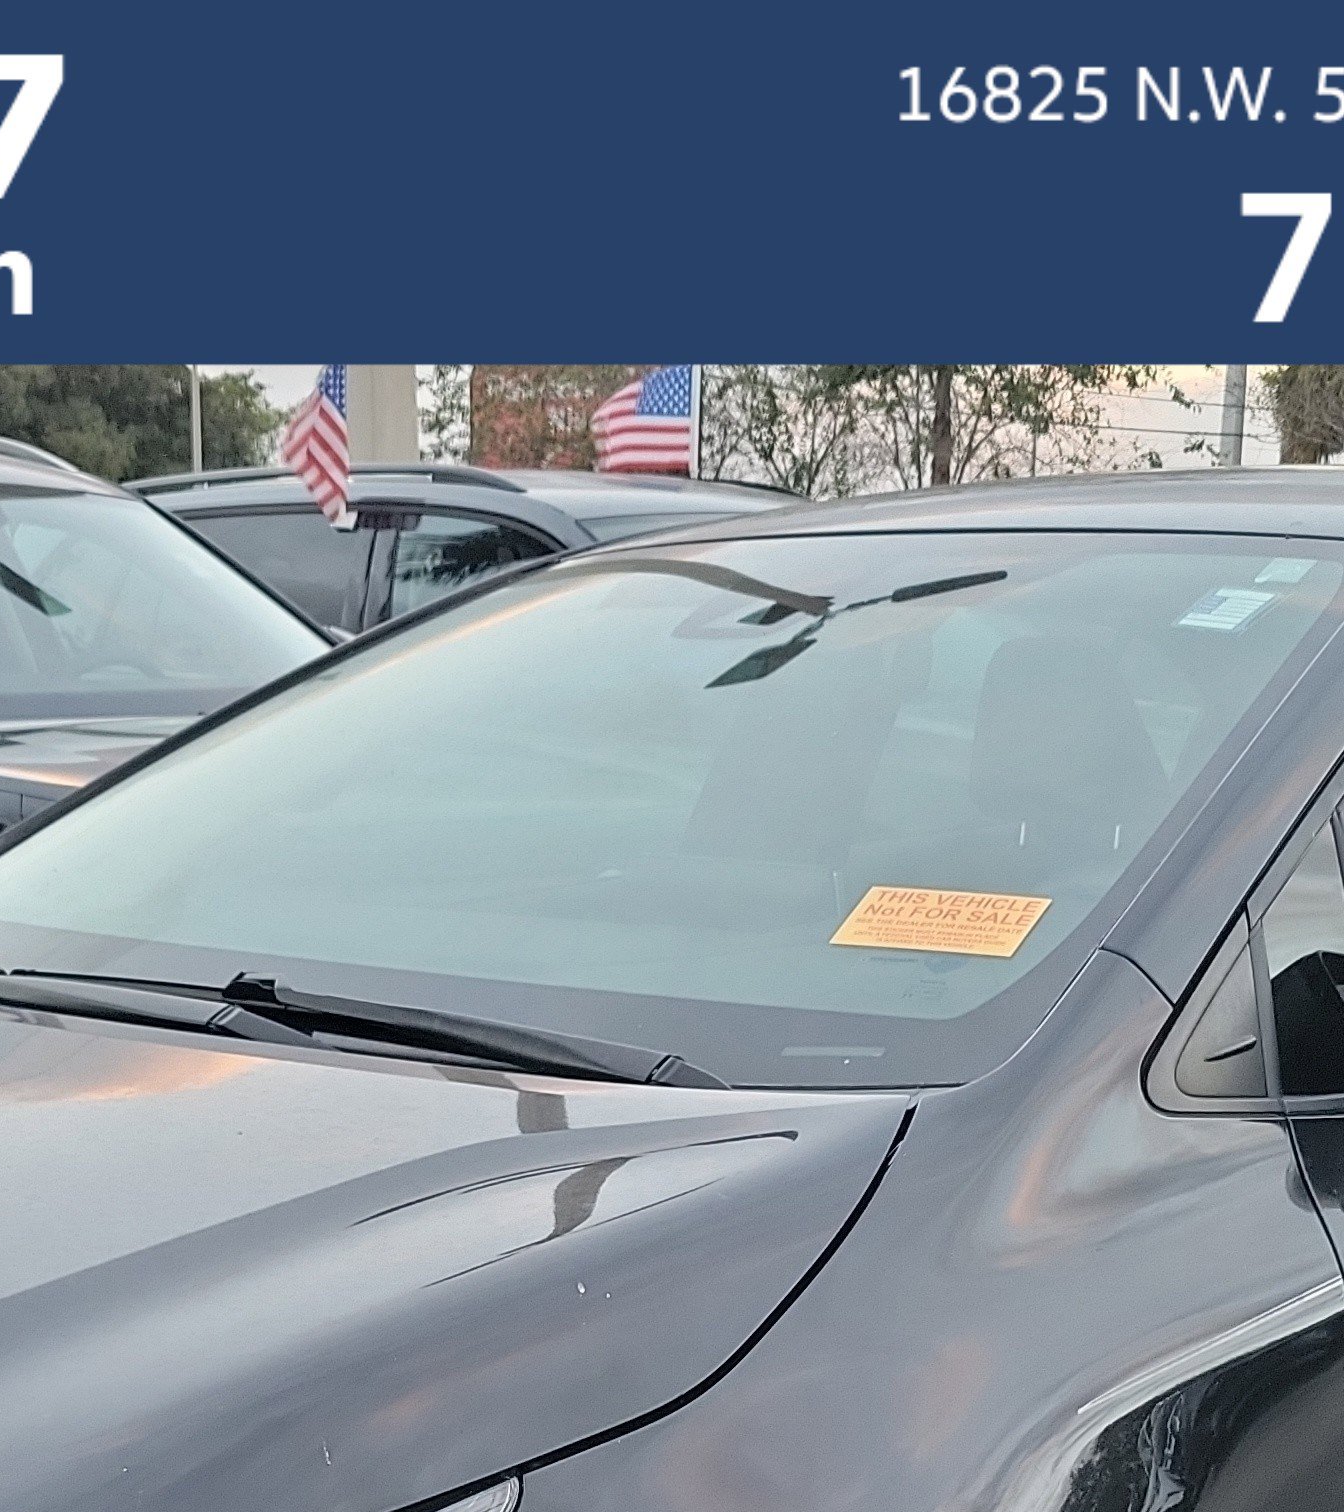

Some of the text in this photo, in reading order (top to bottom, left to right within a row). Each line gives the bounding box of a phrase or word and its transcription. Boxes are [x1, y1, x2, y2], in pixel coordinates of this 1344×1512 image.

[877, 890, 1042, 913] THIS VEHICLE
[909, 906, 962, 921] FOR
[966, 910, 1037, 927] SALE
